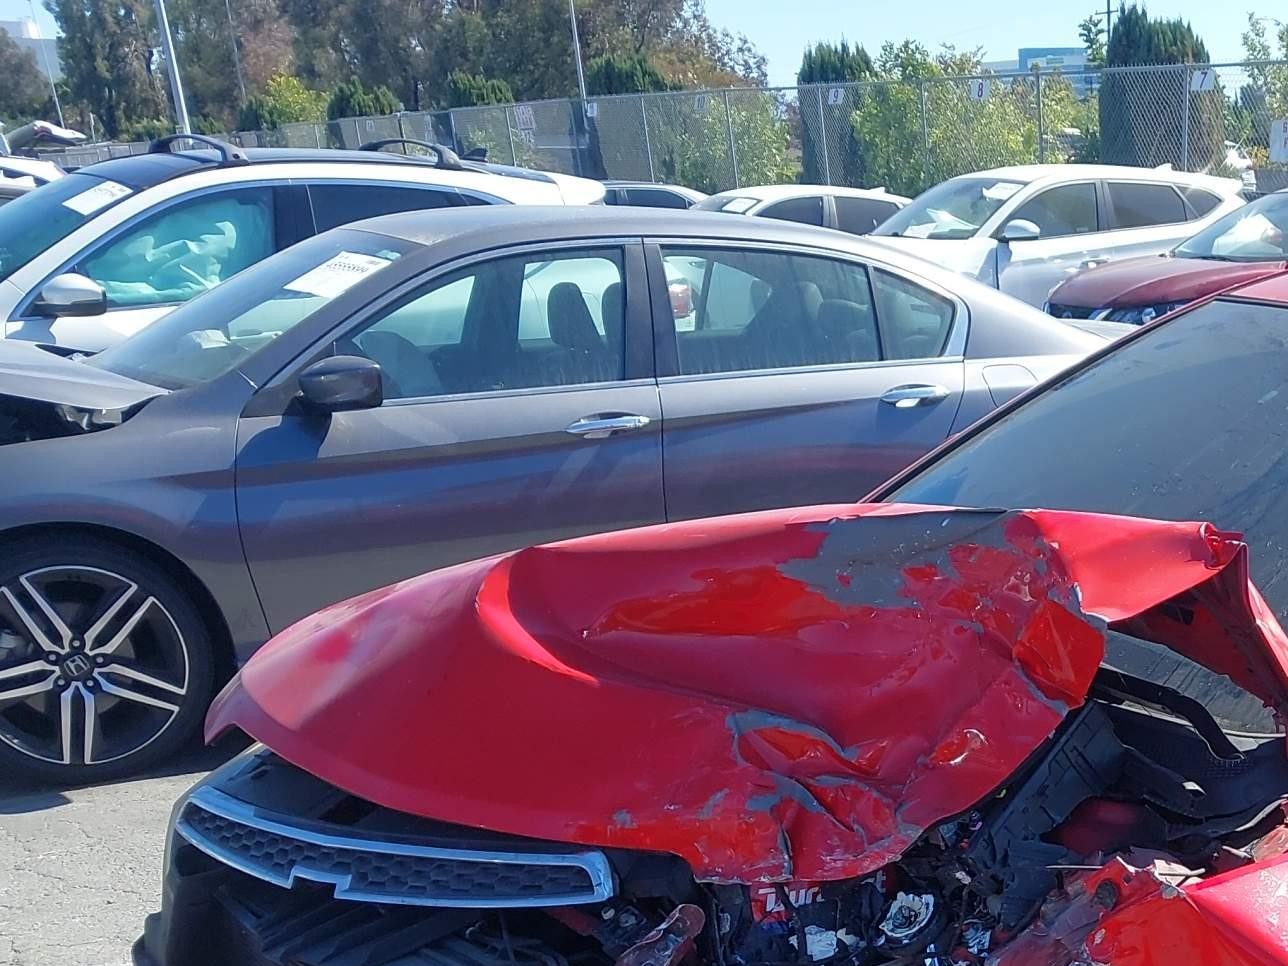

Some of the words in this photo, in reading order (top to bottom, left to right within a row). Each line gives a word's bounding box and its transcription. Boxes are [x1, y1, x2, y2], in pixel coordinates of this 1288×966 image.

[1200, 71, 1208, 89] 7
[833, 89, 839, 103] 9
[977, 82, 984, 98] 8
